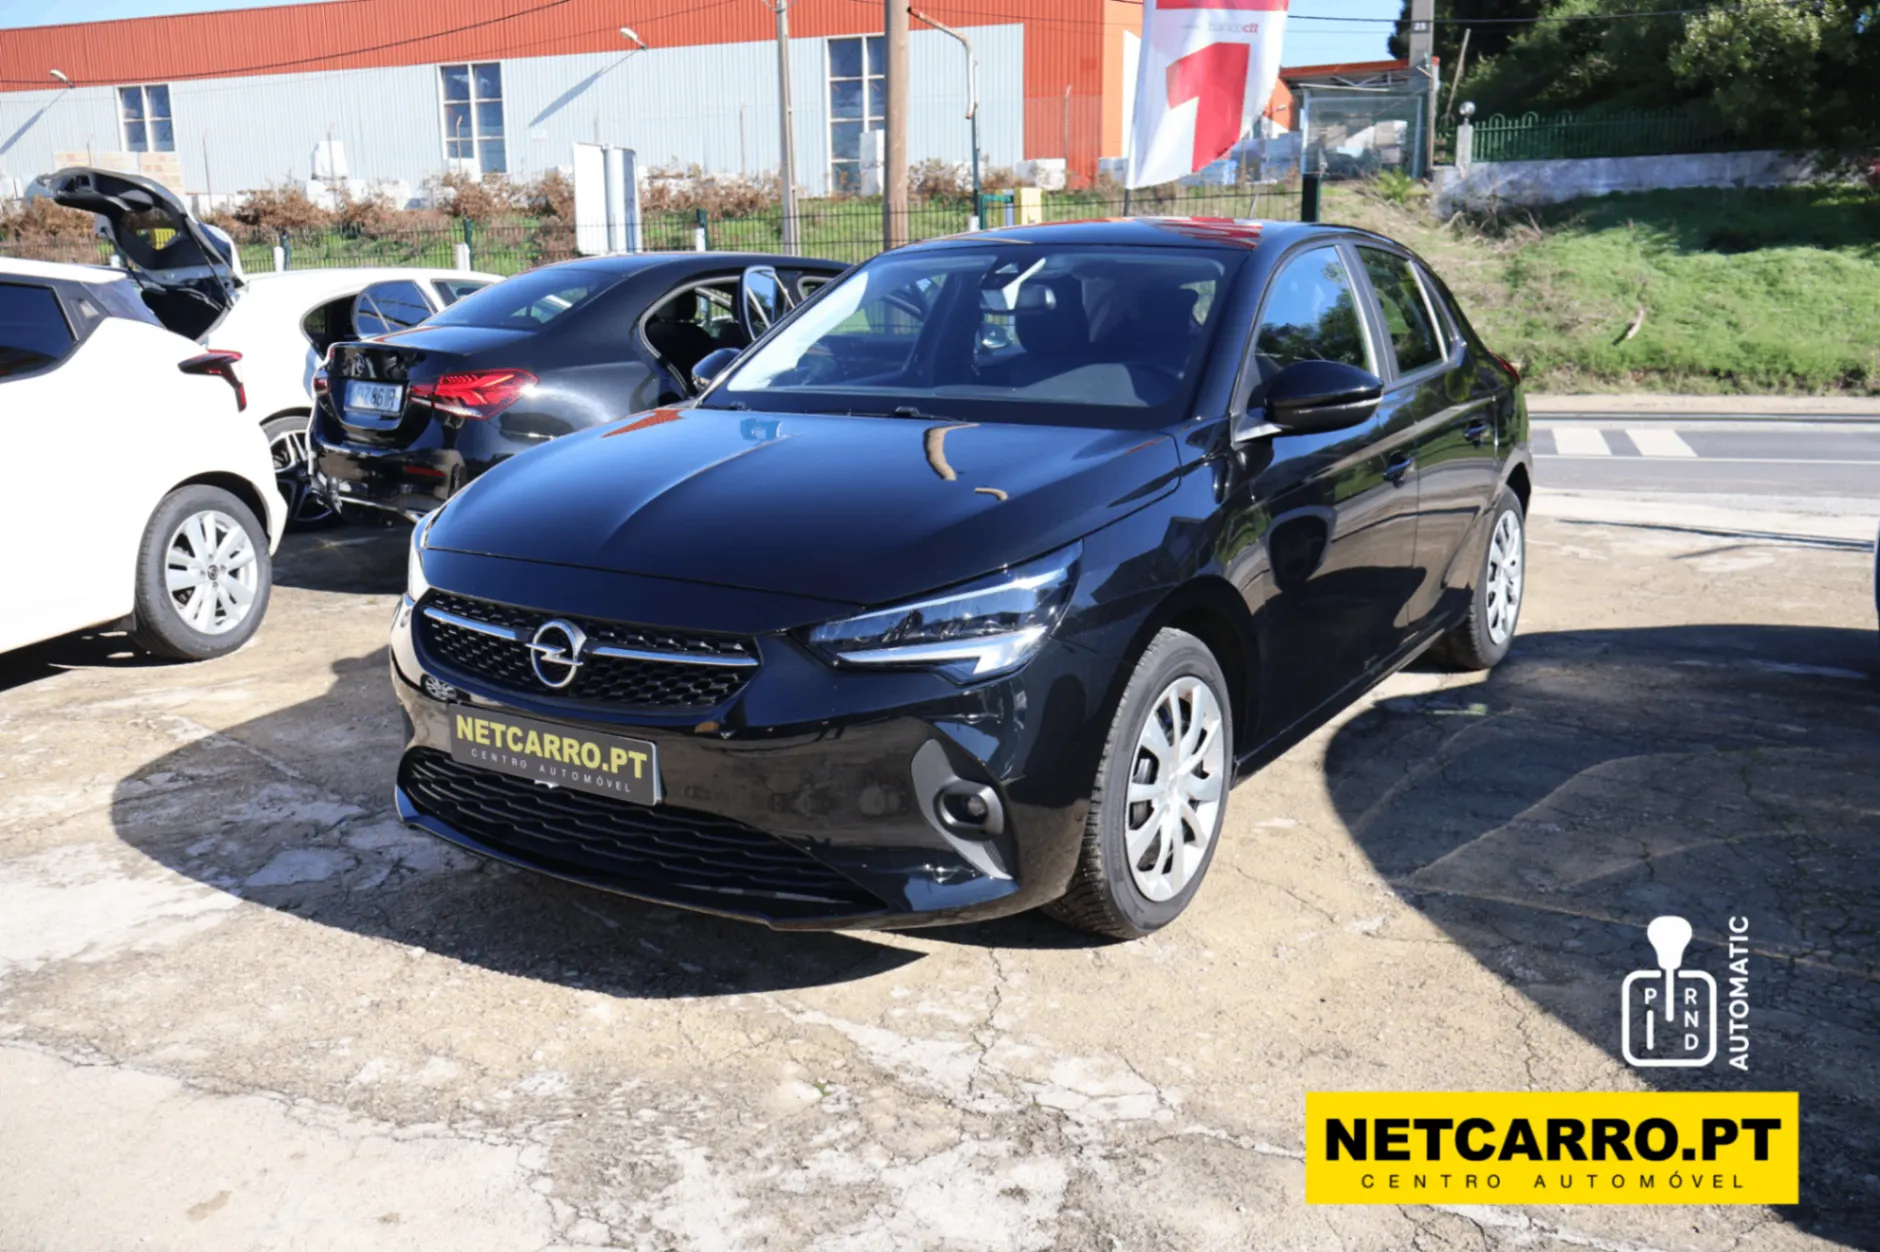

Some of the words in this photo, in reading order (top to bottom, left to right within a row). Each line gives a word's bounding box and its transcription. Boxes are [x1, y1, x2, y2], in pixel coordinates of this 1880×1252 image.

[456, 714, 648, 779] NETCARRO.PT
[471, 748, 528, 769] CENTRO
[539, 764, 632, 793] AUTOMÓVEL
